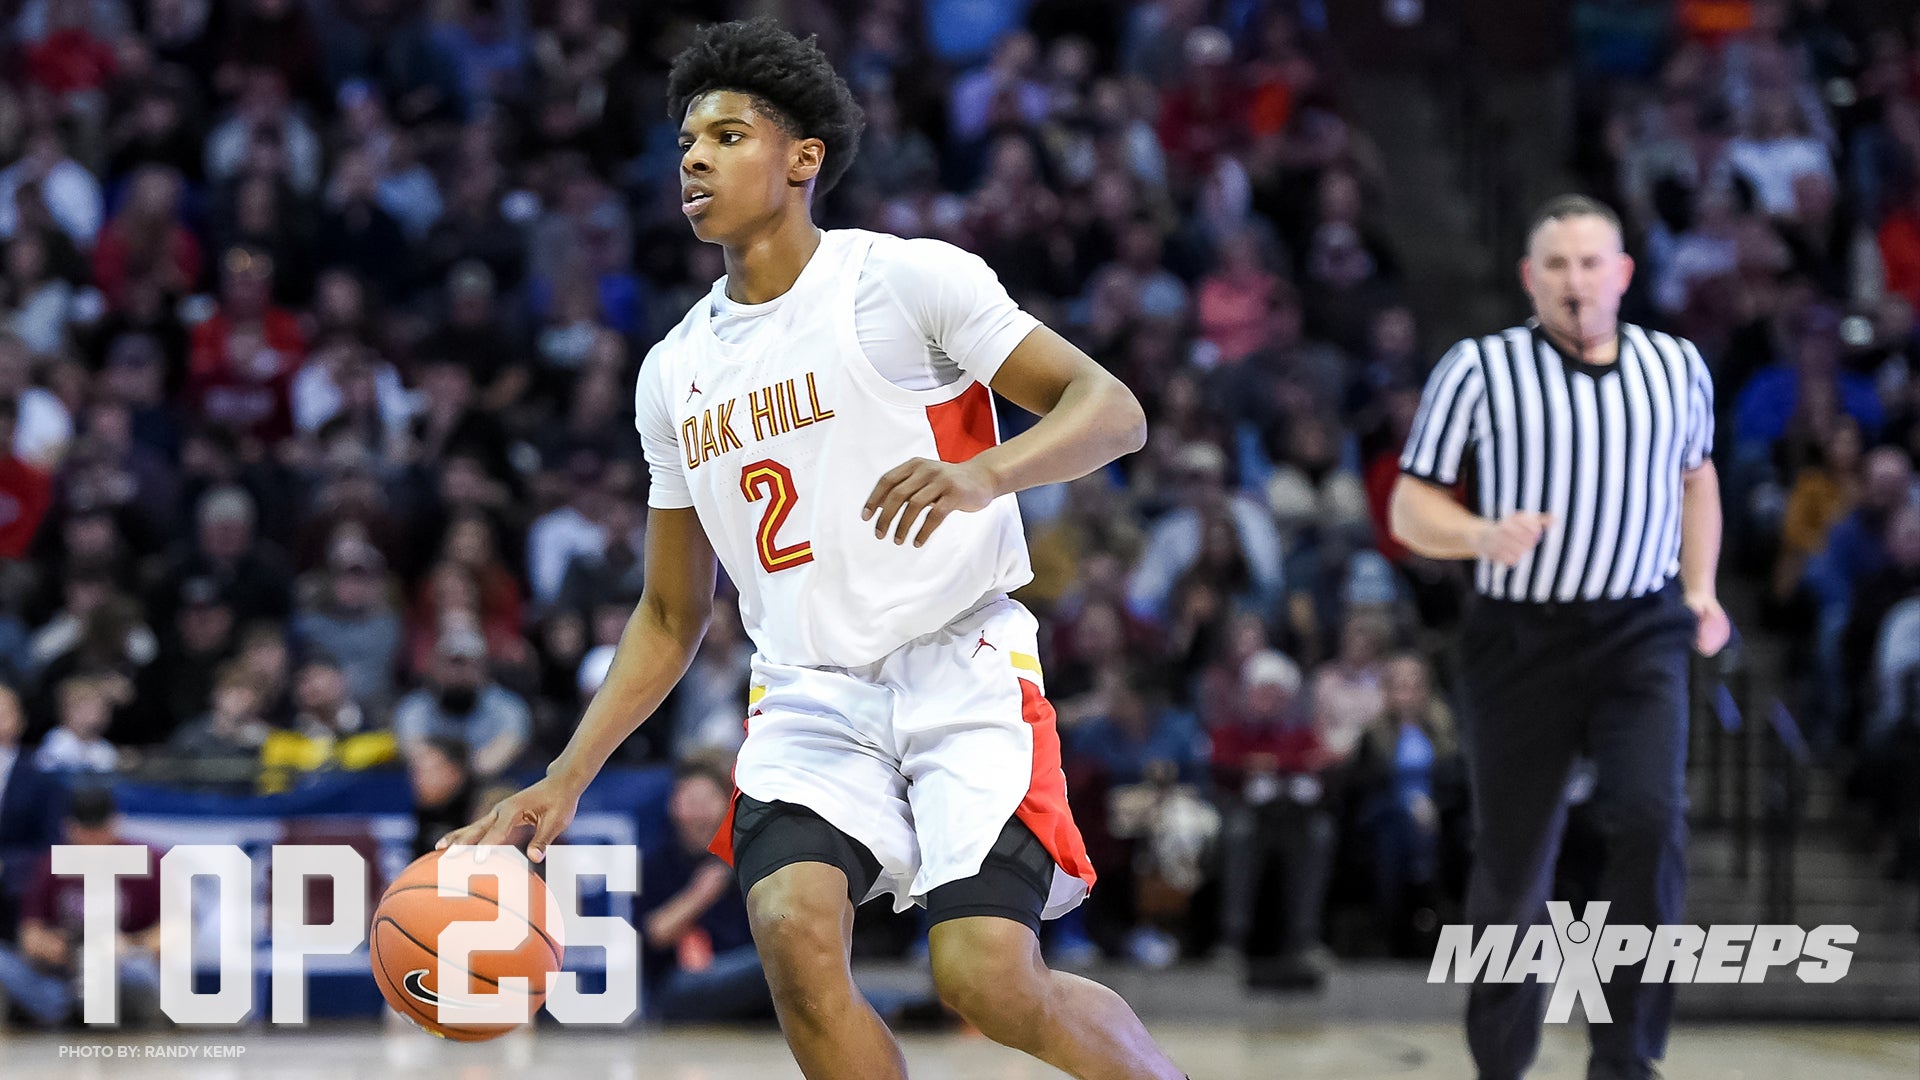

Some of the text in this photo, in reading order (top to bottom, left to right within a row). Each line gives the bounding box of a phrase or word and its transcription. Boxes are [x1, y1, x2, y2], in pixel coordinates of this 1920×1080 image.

[682, 372, 835, 470] OAK HILL
[740, 458, 814, 574] 2
